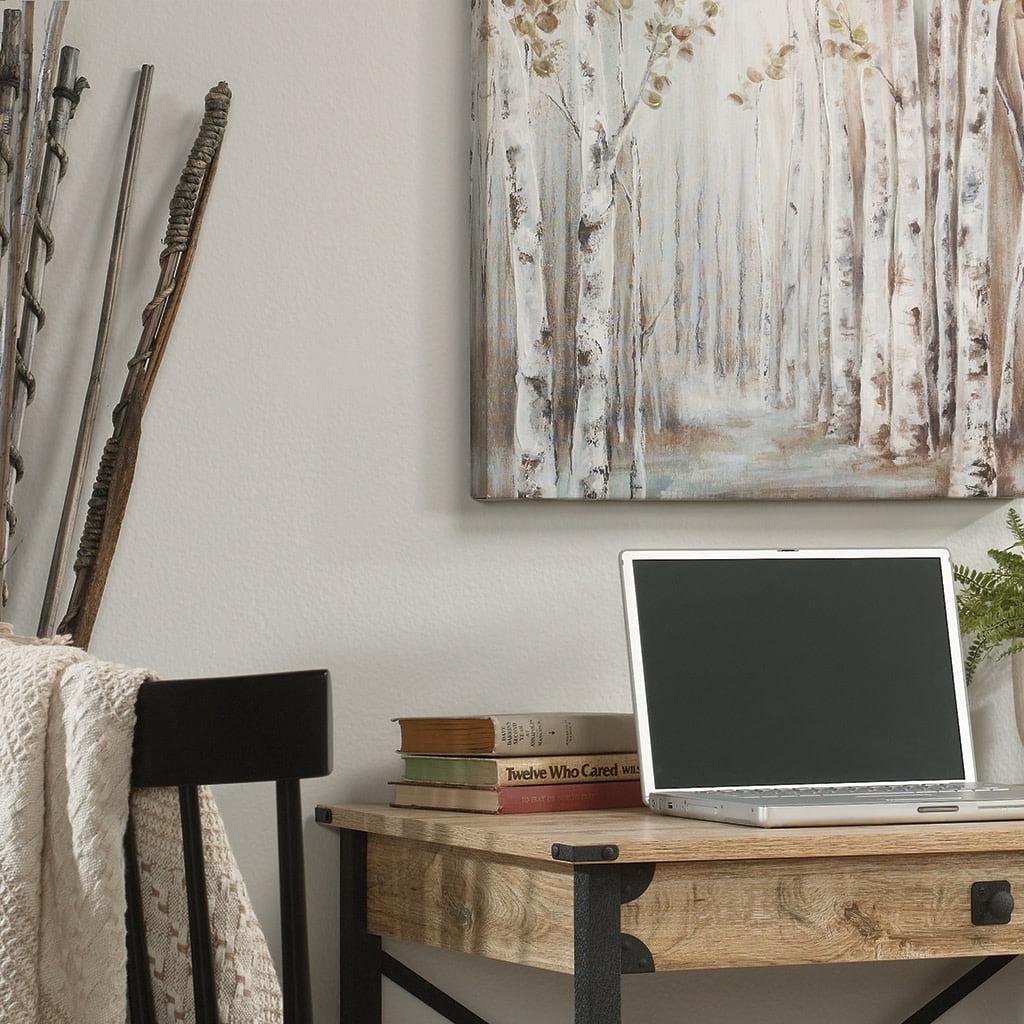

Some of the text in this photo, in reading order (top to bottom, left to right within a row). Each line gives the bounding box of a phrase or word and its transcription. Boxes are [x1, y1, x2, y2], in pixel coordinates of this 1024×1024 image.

[506, 766, 547, 781] Twelve
[549, 765, 579, 779] Who
[581, 763, 618, 777] Cared
